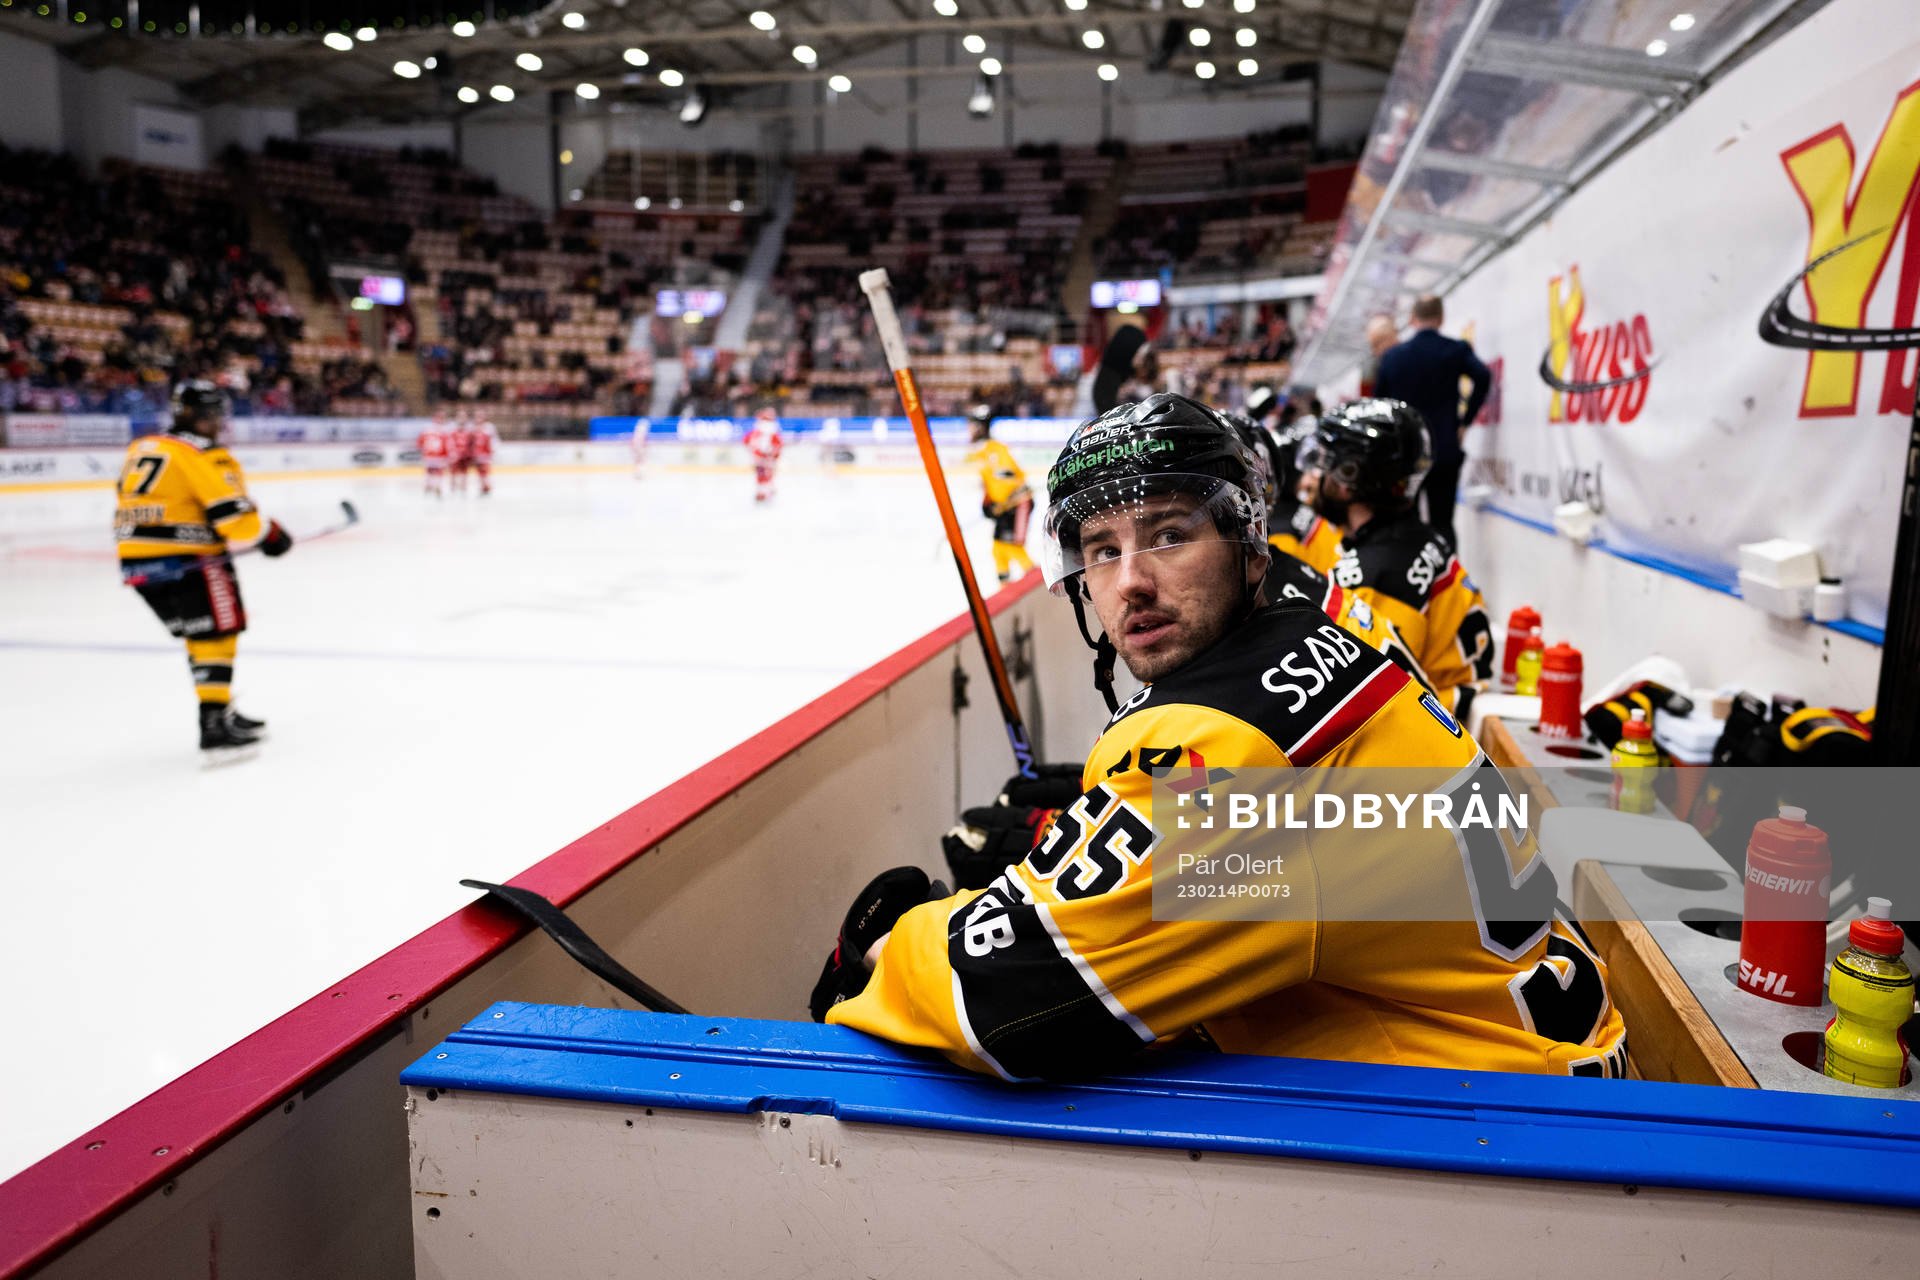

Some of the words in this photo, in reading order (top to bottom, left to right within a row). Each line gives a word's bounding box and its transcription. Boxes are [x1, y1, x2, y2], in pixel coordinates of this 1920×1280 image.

[1080, 424, 1132, 450] BAUER
[1058, 438, 1175, 482] Läkarjouren
[1261, 625, 1361, 714] SSAB
[1748, 867, 1815, 896] ENERVIT
[1738, 958, 1797, 998] SHL
